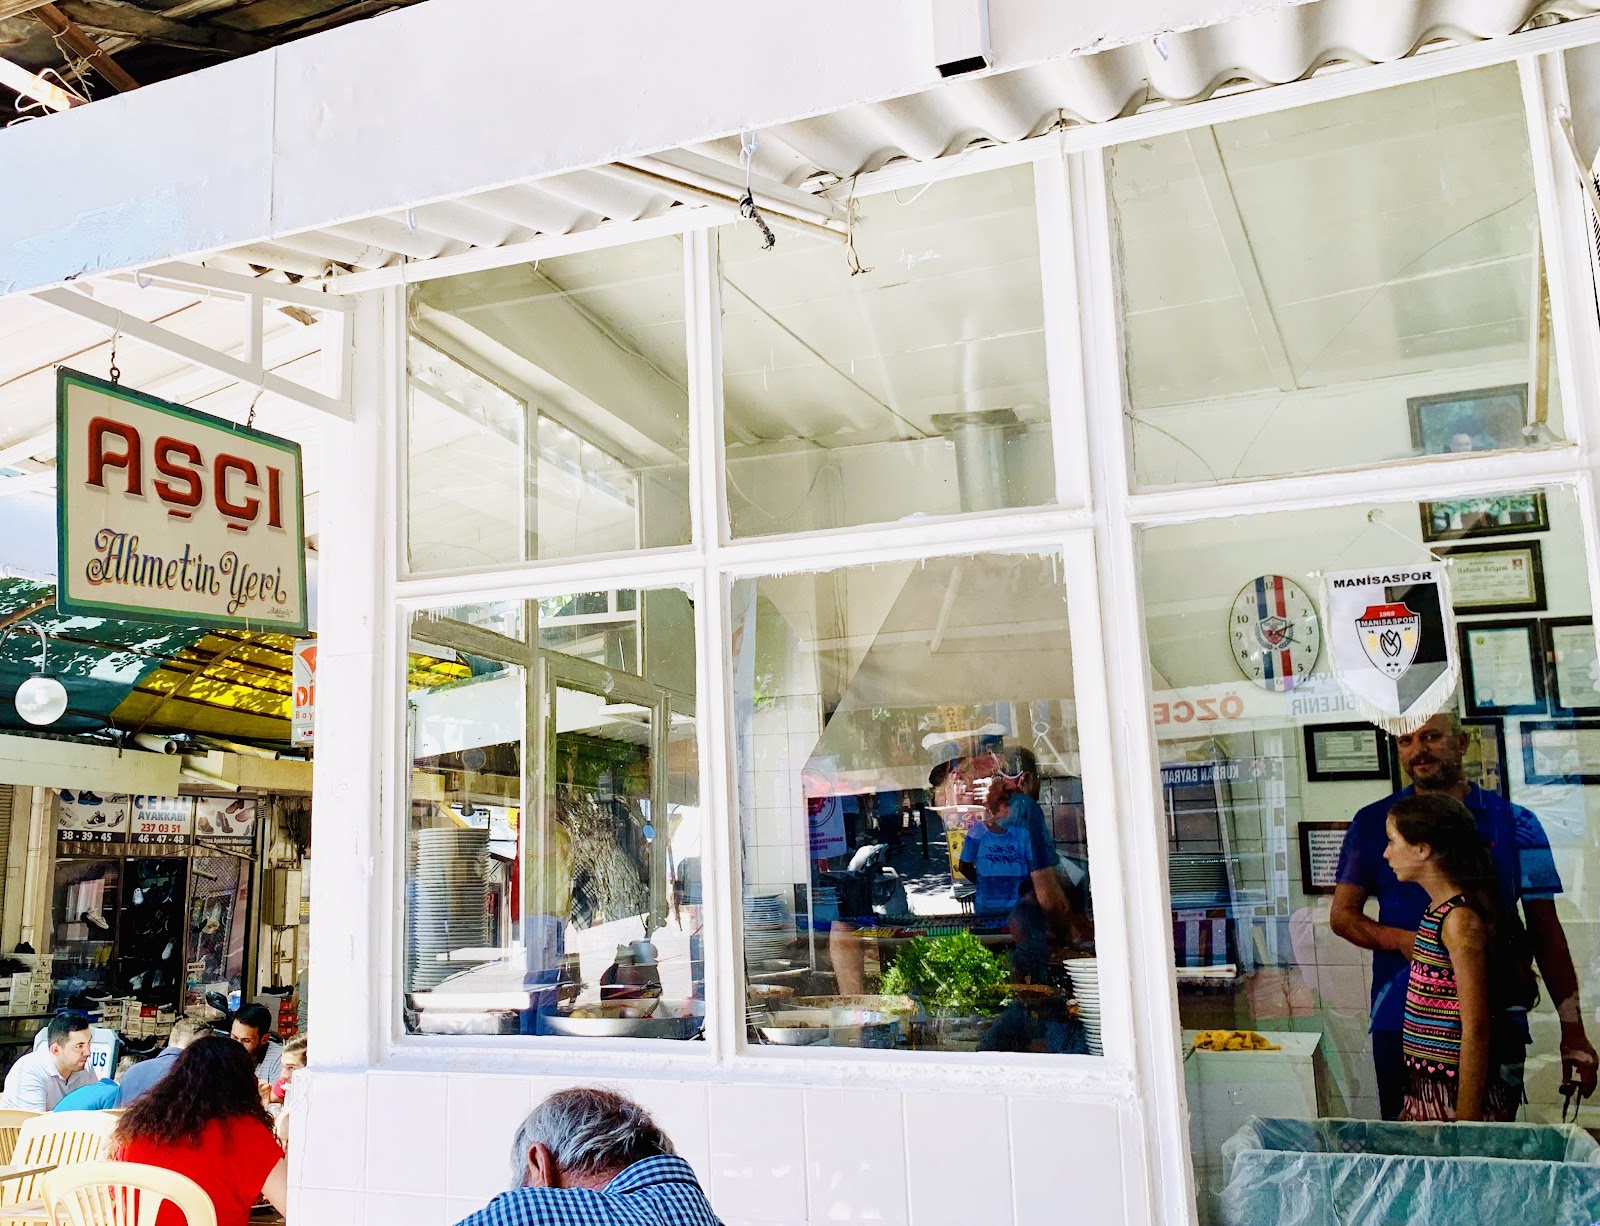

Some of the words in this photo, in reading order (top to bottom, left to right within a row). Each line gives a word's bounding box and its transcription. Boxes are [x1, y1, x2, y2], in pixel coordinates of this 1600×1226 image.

[85, 416, 284, 532] AŞÇI
[86, 528, 220, 596] Ahmet'in
[219, 551, 287, 616] Yeri
[1333, 571, 1432, 588] MANİSASPOR
[1246, 596, 1255, 604] 11
[1301, 609, 1308, 617] 2
[1237, 615, 1249, 623] 10
[1361, 616, 1416, 627] MANİSASPOR
[1306, 627, 1313, 635] 3
[1235, 632, 1243, 640] 9
[1305, 645, 1312, 653] 4
[1241, 650, 1248, 658] 8
[1253, 667, 1260, 676] 7
[1297, 663, 1304, 672] 5
[138, 811, 186, 822] AYAKKABI
[141, 823, 156, 833] 237
[158, 823, 169, 833] 03
[171, 824, 181, 833] 51
[62, 830, 74, 840] 38
[81, 831, 93, 841] 39
[100, 832, 112, 842] 45
[138, 834, 150, 844] 46
[156, 834, 167, 844] 47
[174, 835, 184, 844] 48
